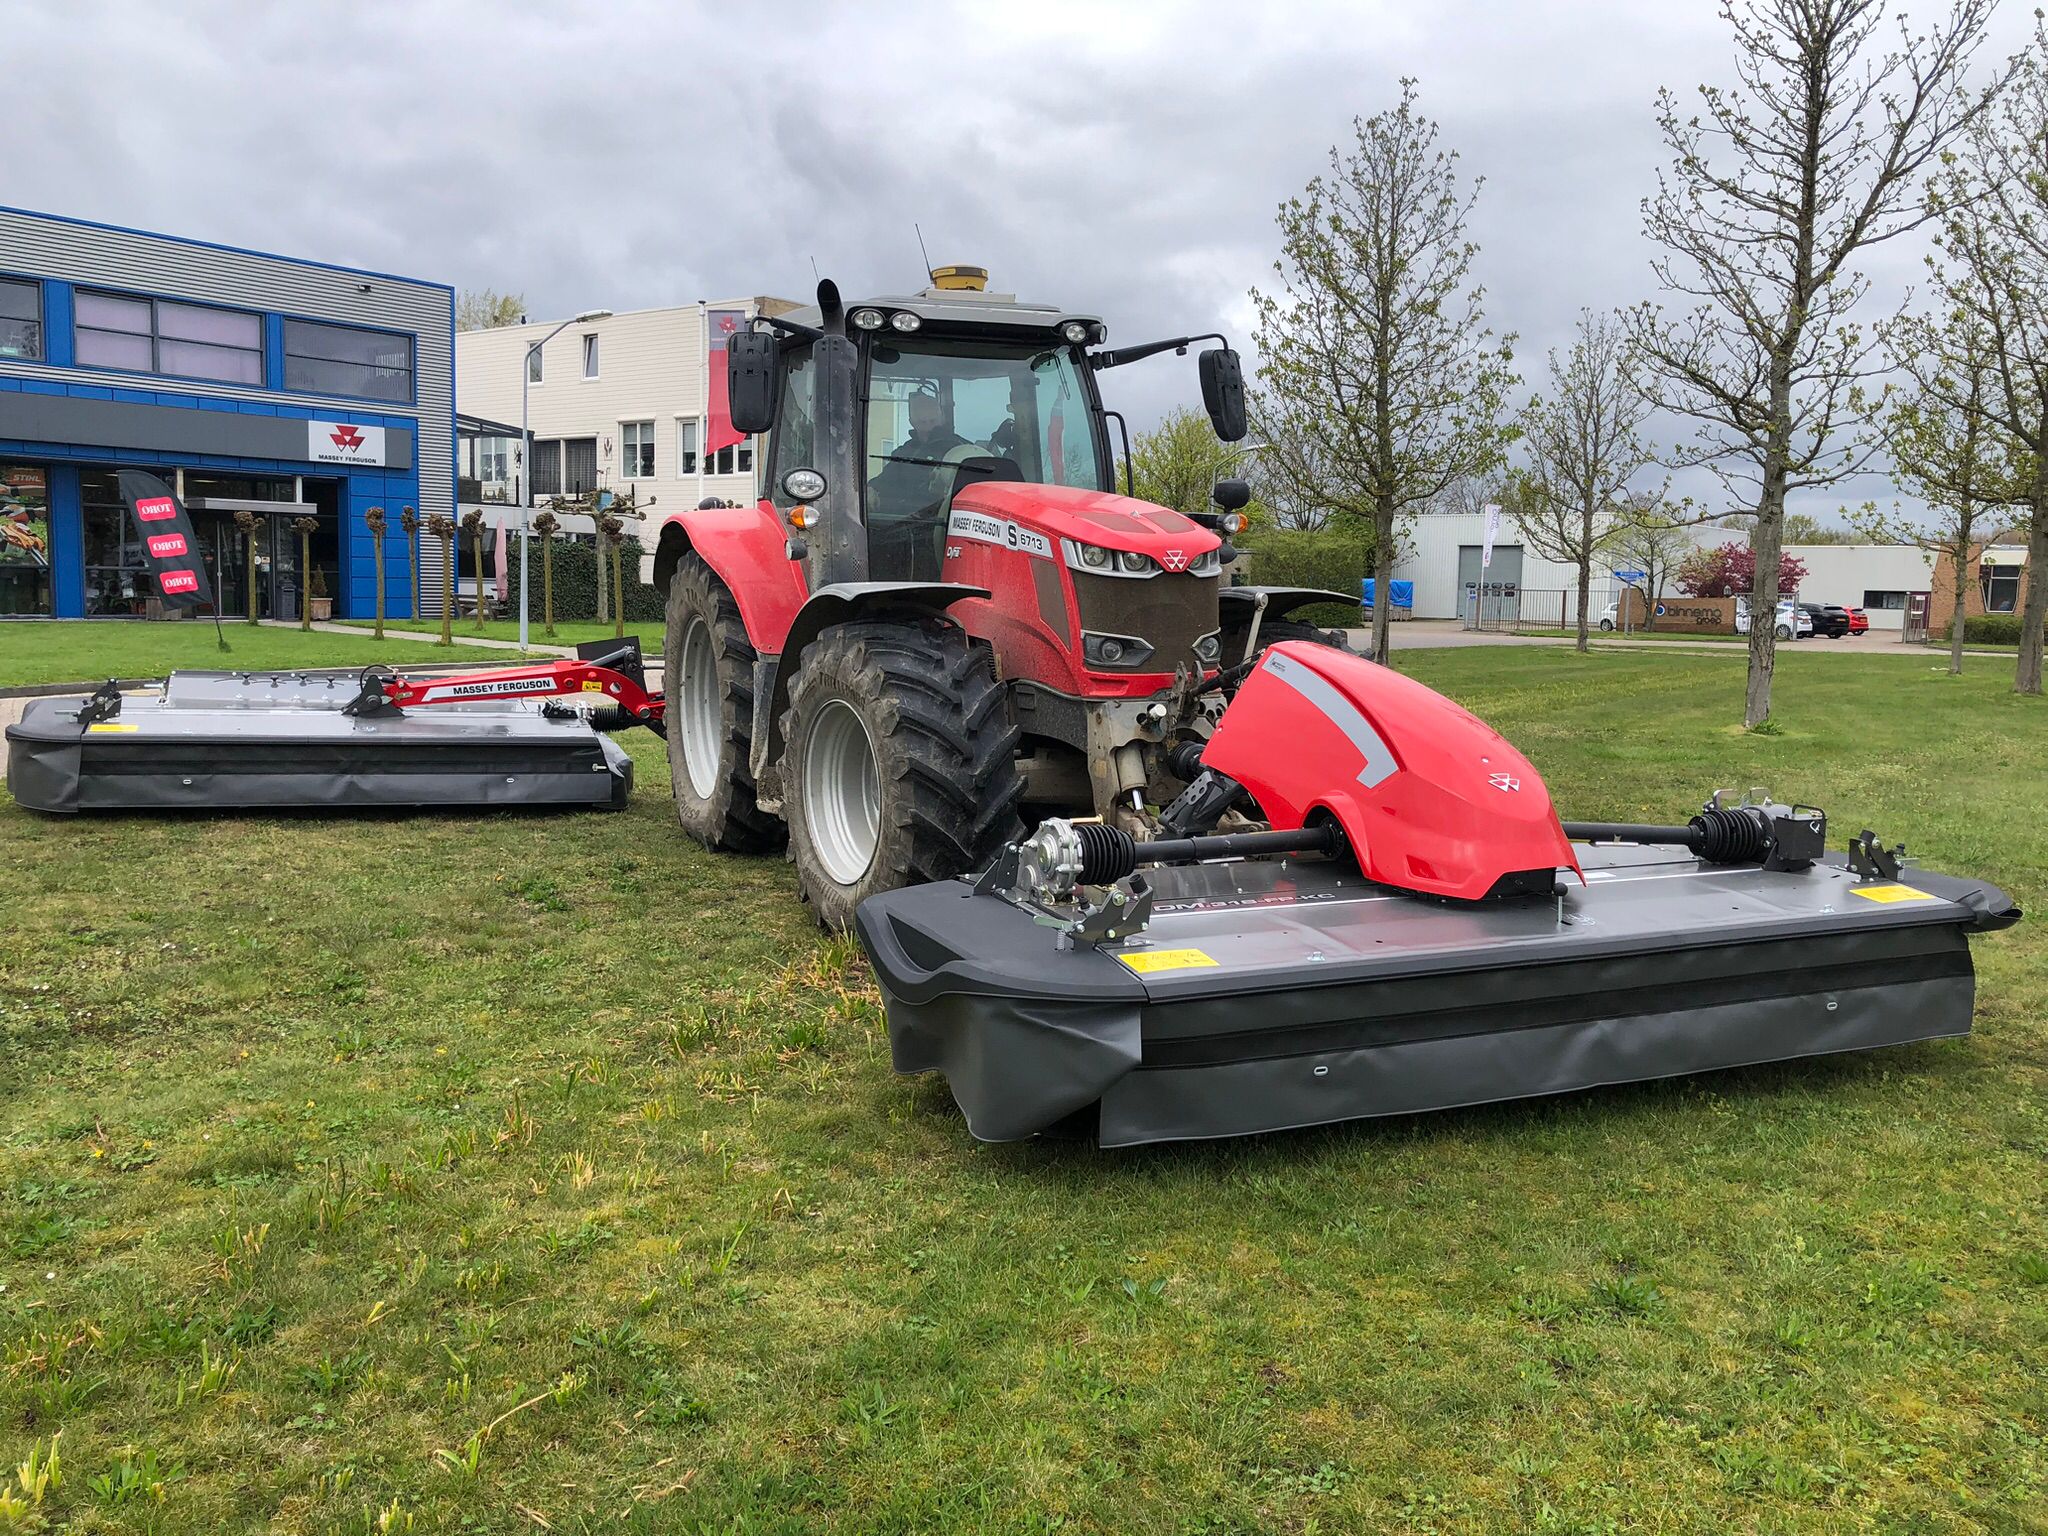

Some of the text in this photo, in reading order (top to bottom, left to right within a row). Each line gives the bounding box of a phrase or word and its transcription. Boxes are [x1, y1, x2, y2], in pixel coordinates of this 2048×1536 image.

[345, 456, 376, 464] FERGUSON
[953, 516, 1043, 550] MASSEY FERGUSON S 6713
[453, 679, 551, 695] MASSEY FERGUSON
